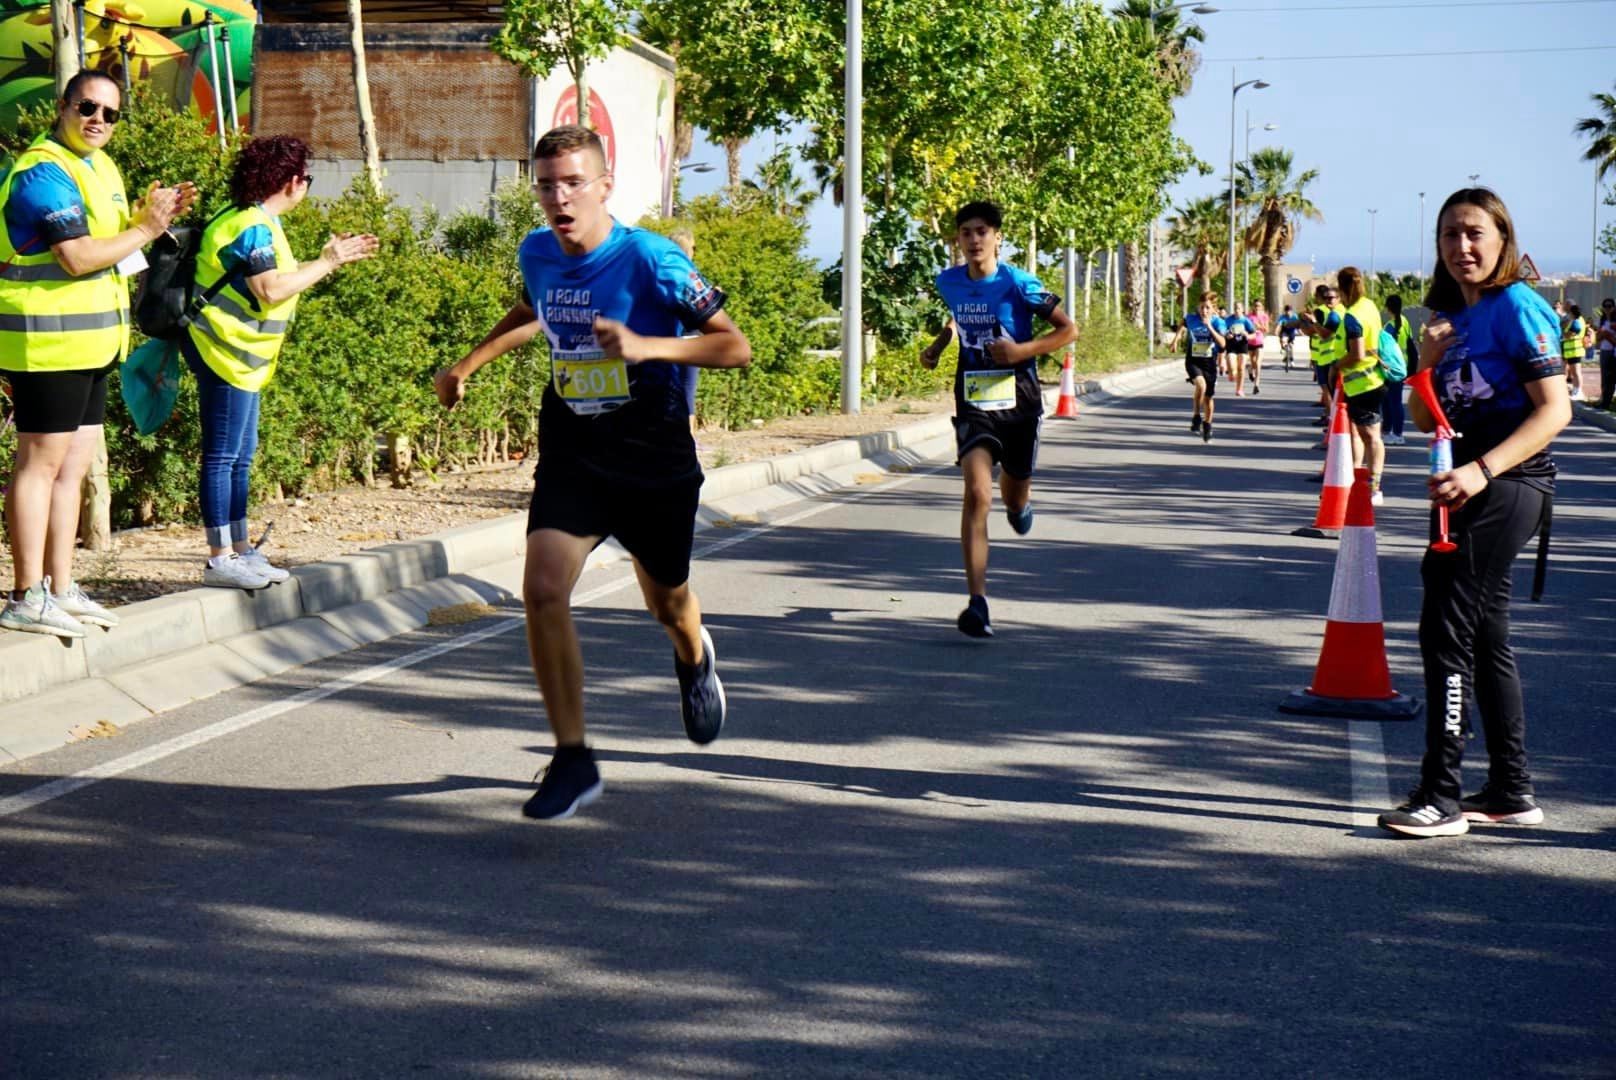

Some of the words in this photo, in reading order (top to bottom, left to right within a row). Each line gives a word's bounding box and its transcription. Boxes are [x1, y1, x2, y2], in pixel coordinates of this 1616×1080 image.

[556, 288, 590, 305] ROAD
[964, 303, 988, 313] ROAD
[957, 314, 996, 324] RUNNING
[573, 367, 622, 395] 601
